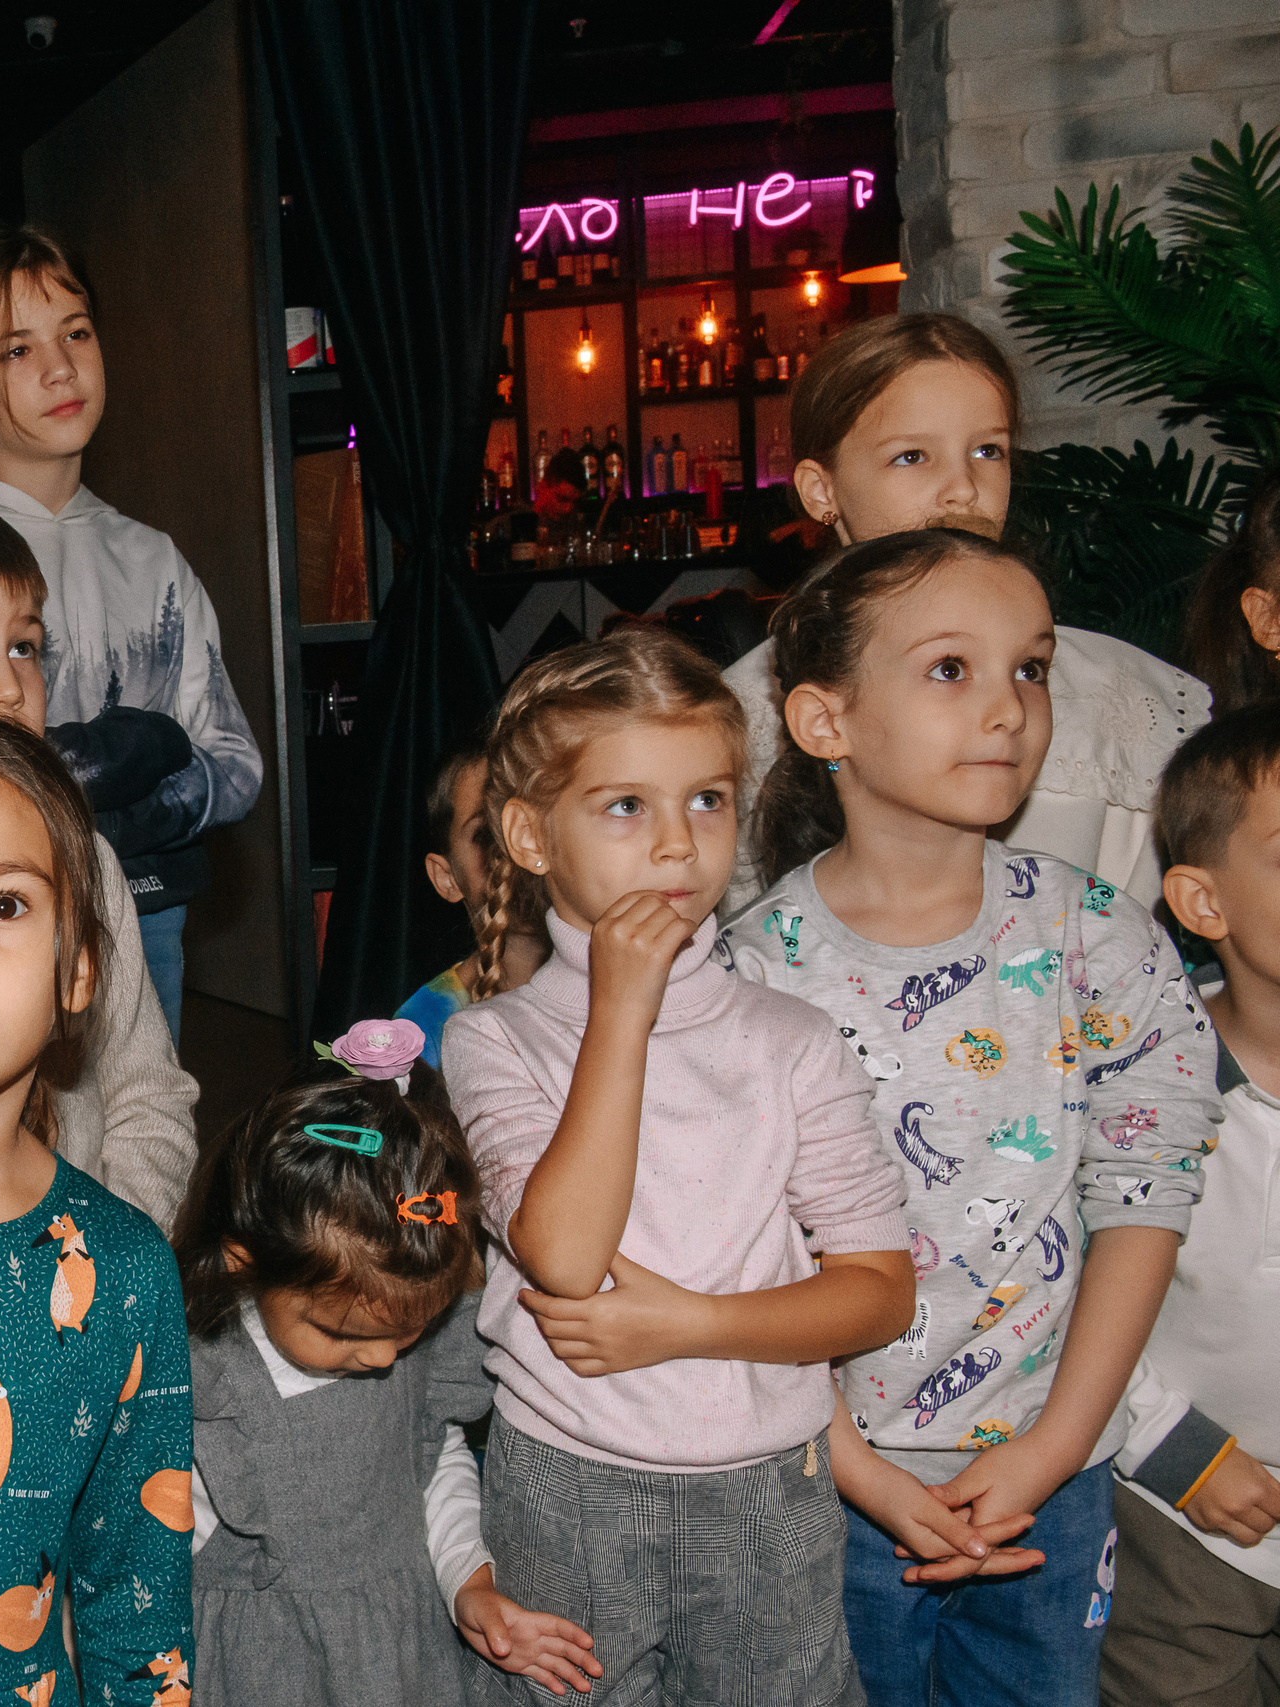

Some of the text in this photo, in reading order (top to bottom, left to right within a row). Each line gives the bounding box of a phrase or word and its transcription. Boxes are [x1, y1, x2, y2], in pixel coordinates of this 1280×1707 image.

[128, 875, 164, 895] OUBLES
[145, 1389, 159, 1397] LOOK
[161, 1387, 168, 1395] AT
[170, 1386, 179, 1395] THE
[8, 1487, 15, 1498] TO
[15, 1489, 27, 1498] LOOK
